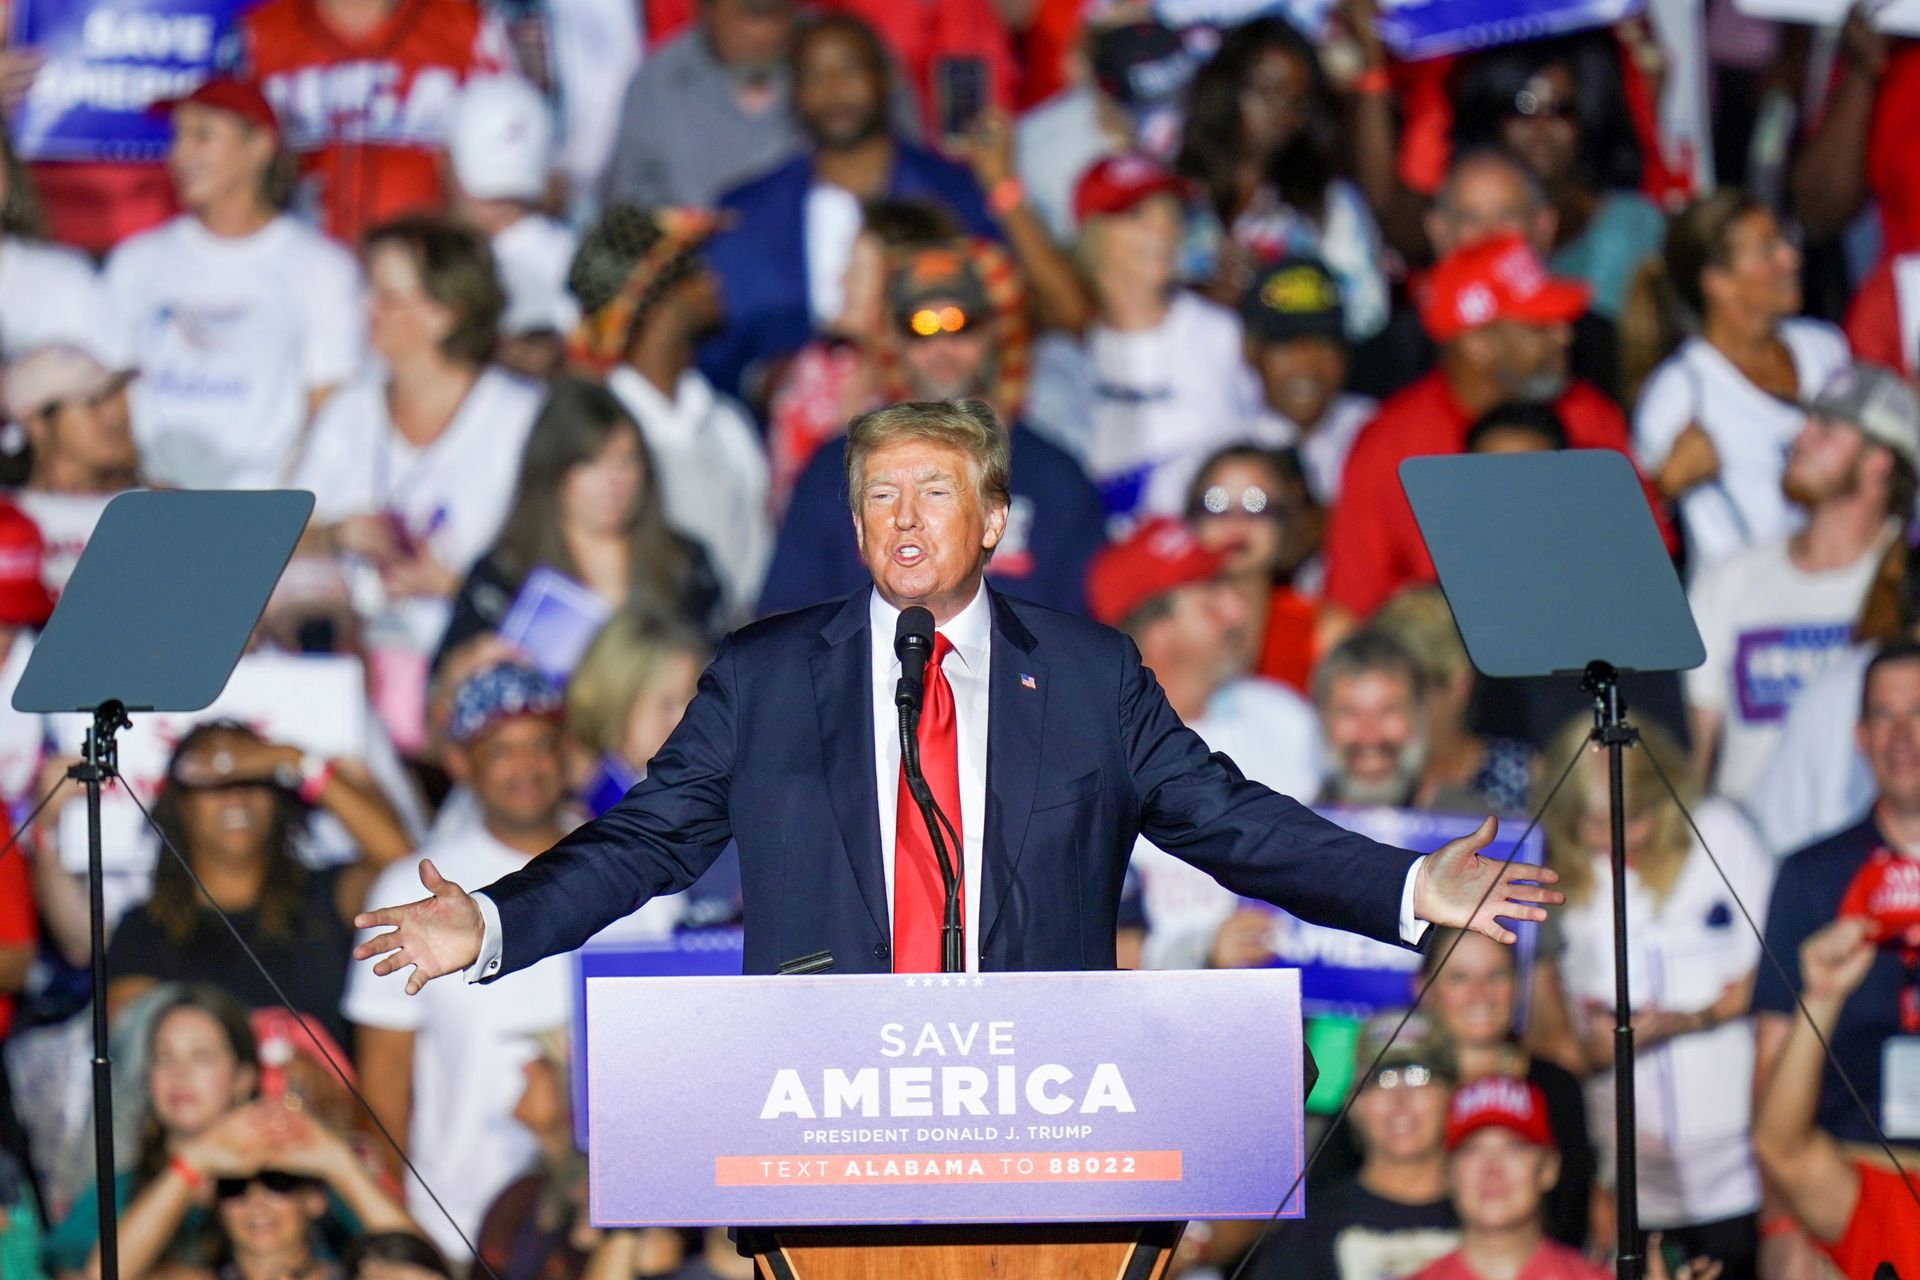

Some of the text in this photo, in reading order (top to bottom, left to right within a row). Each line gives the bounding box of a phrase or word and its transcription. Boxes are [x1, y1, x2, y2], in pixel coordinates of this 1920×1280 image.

[879, 1021, 1015, 1057] SAVE
[759, 1063, 1137, 1120] AMERICA
[803, 1125, 1093, 1144] PRESIDENT DONALD J. TRUMP
[759, 1156, 1136, 1178] TEXT ALABAMA TO 88022
